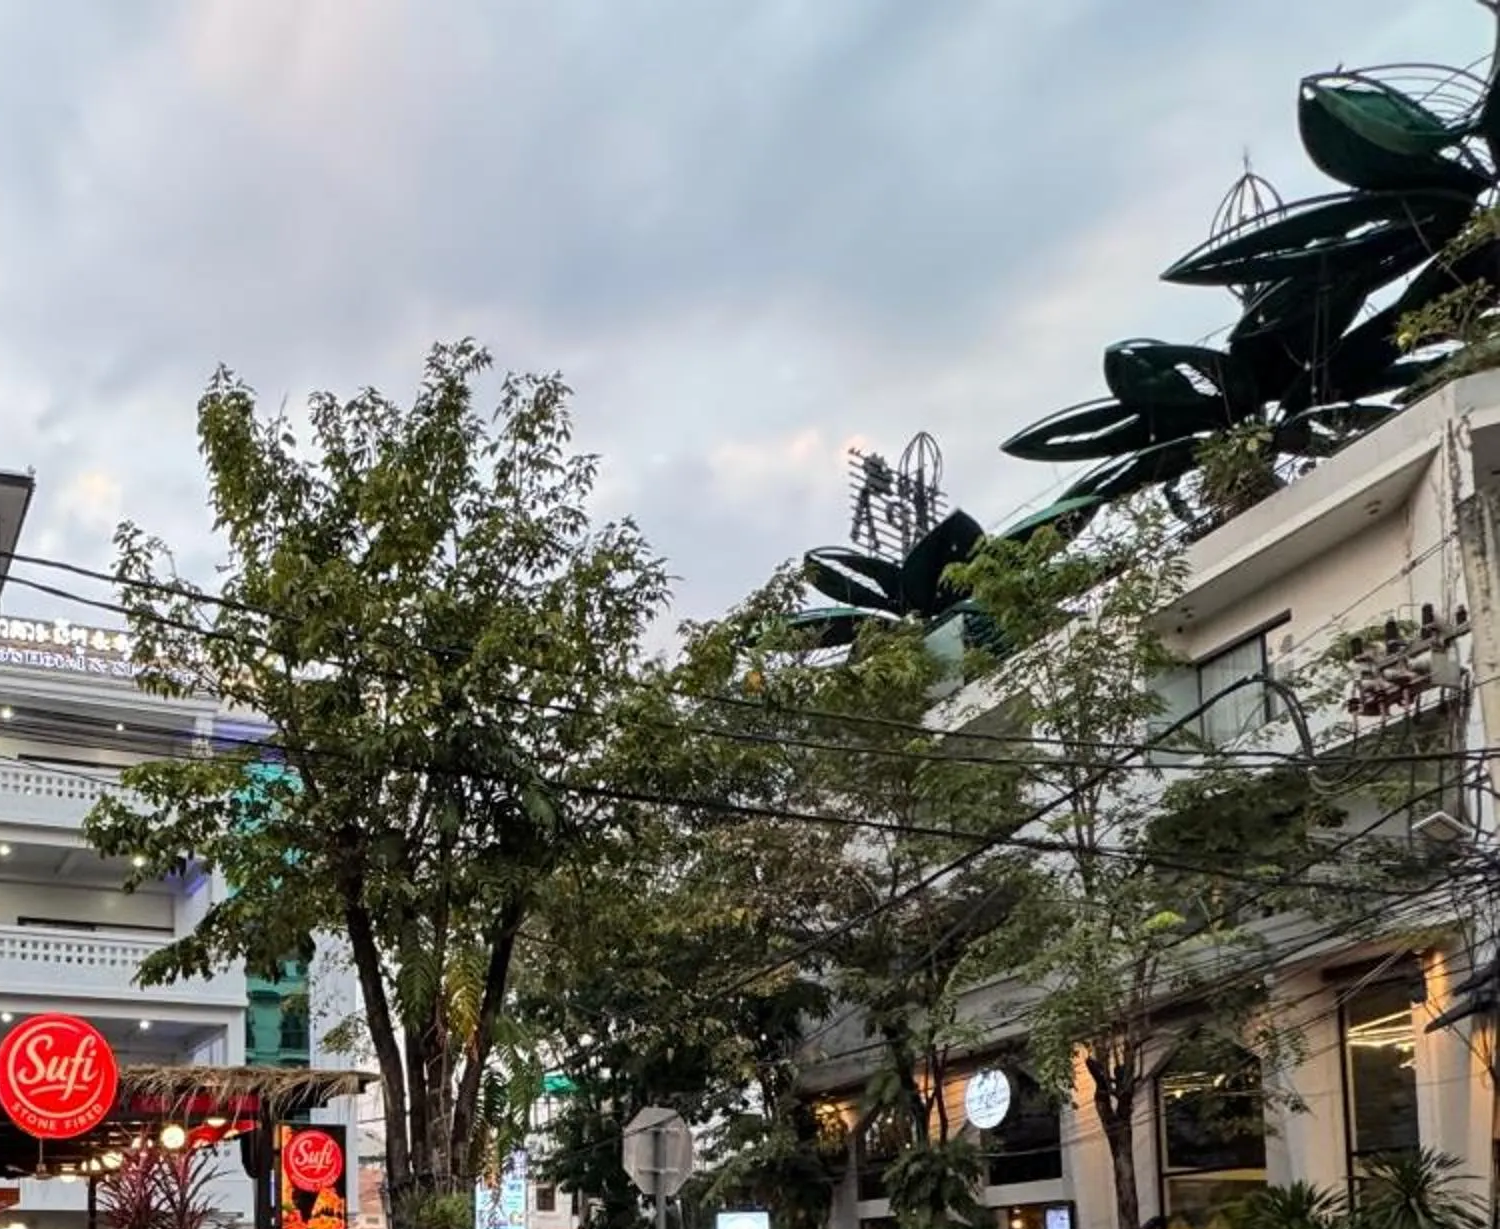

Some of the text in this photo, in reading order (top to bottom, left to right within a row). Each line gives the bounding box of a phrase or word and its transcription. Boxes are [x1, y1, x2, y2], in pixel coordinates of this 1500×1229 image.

[17, 1033, 99, 1101] Sufi
[10, 1101, 57, 1130] STONE
[295, 1139, 334, 1173] Sufi
